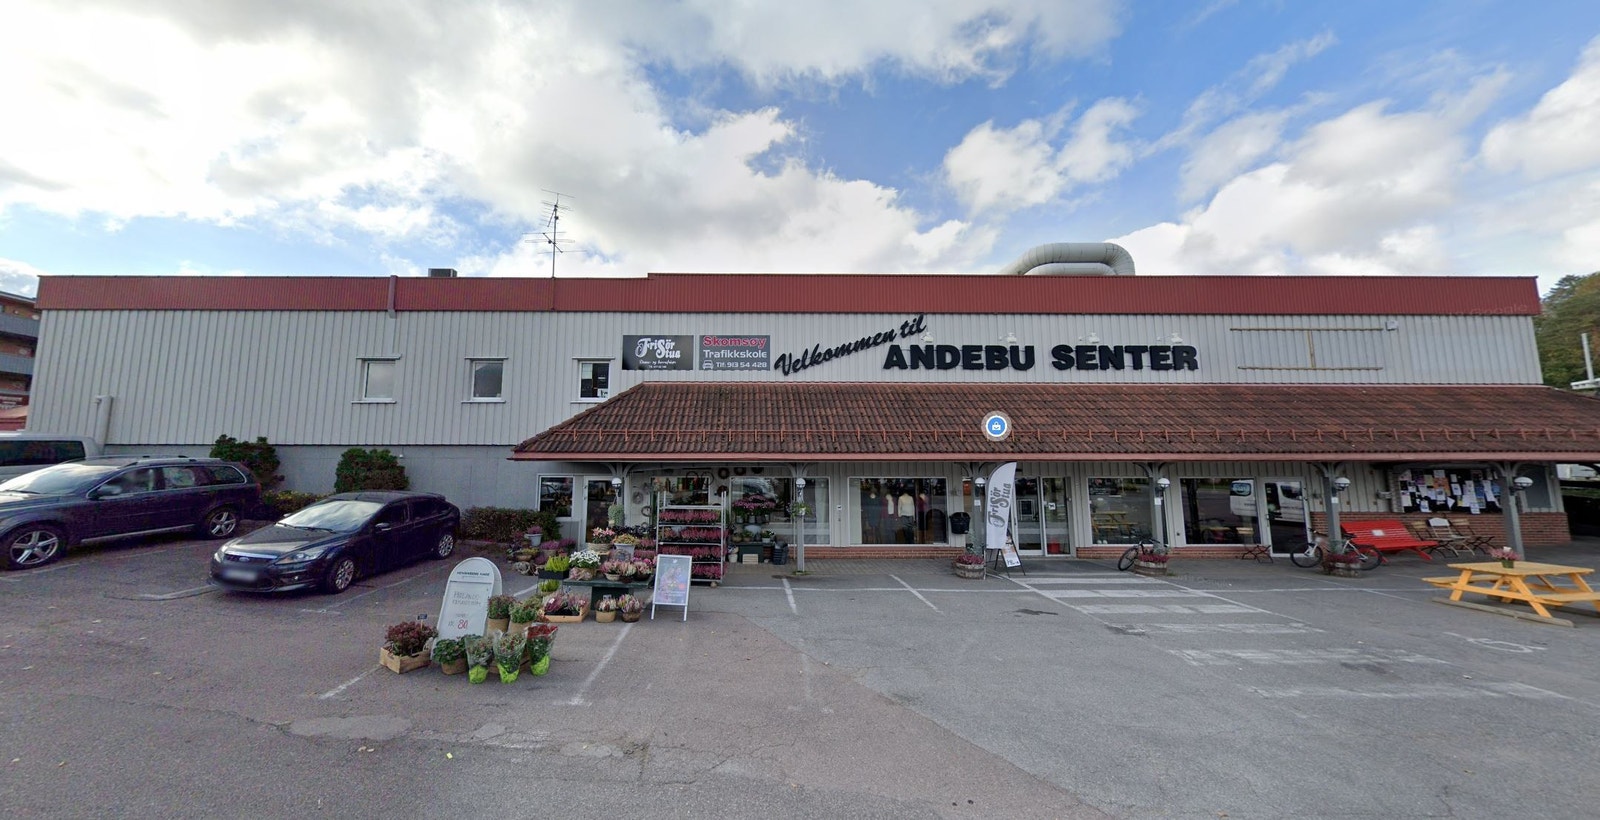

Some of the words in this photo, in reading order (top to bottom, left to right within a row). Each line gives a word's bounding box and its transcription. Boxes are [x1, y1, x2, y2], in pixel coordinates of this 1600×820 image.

[702, 335, 767, 349] Skomsøy
[773, 327, 898, 376] Velkommen
[898, 313, 927, 338] til
[702, 349, 768, 358] Trafikkskole
[882, 344, 1035, 371] ANDEBU
[1051, 343, 1199, 371] SENTER
